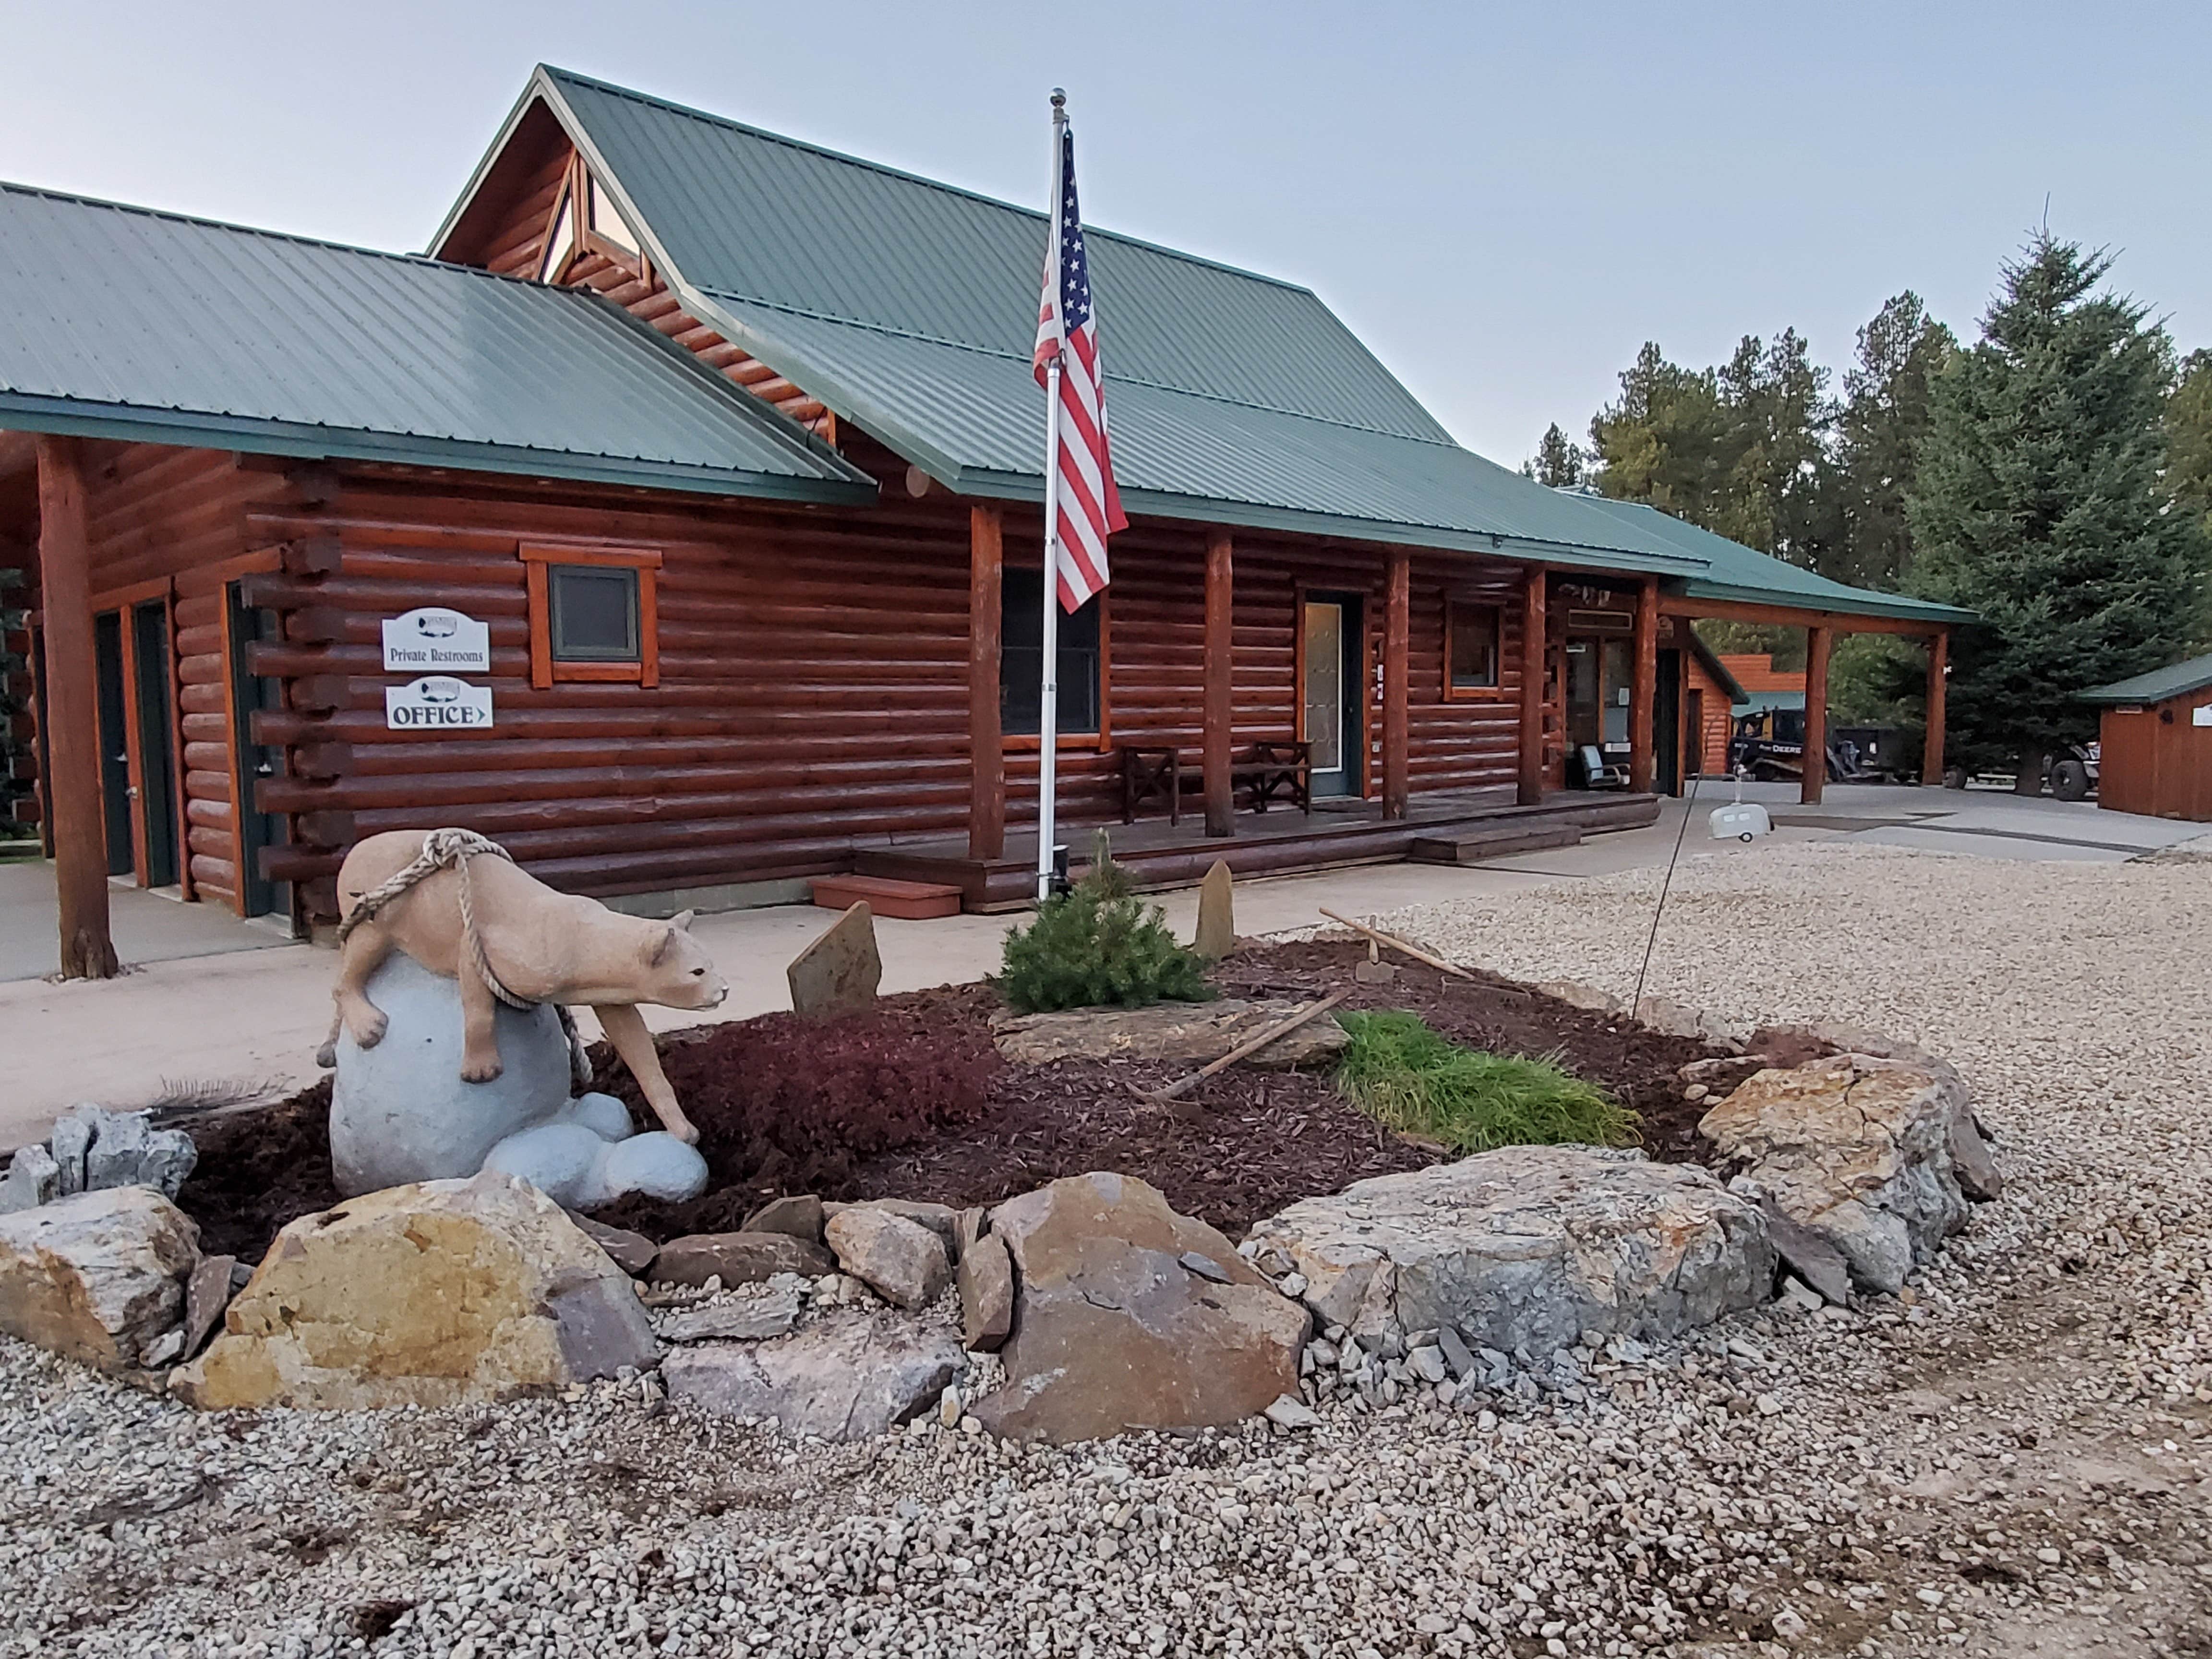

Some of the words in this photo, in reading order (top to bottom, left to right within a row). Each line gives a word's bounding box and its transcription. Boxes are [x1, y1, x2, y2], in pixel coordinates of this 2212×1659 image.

[390, 648, 426, 661] Private
[431, 648, 483, 662] Restrooms
[393, 706, 473, 724] OFFICE
